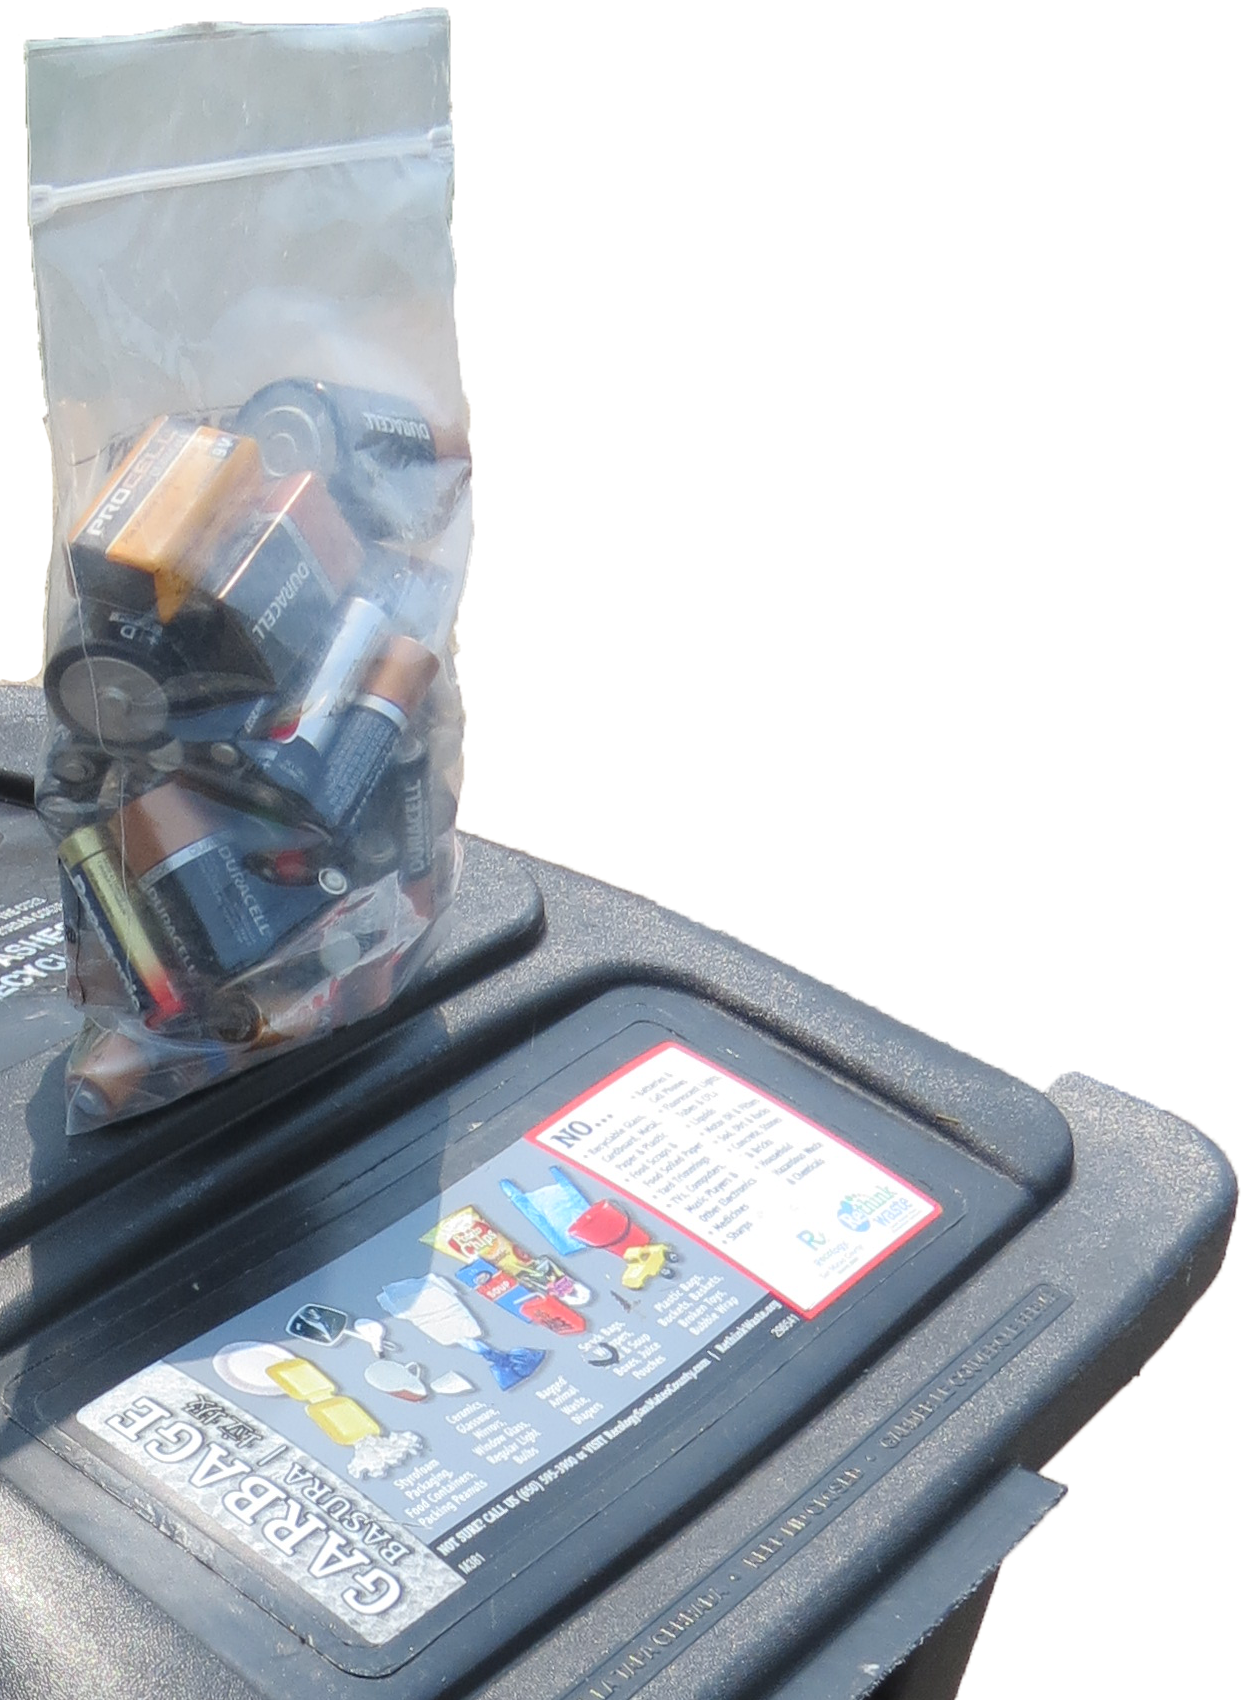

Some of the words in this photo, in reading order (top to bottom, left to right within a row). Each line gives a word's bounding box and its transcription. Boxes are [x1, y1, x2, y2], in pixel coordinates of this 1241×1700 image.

[363, 413, 430, 441] DURACELL
[86, 430, 178, 536] PROCELL
[251, 560, 310, 641] DURACELL
[405, 778, 425, 873] DURACELL
[217, 846, 271, 936] DURACELL
[147, 886, 197, 975] DURACELL
[587, 1128, 625, 1154] Recyclable
[837, 1187, 894, 1228] Rethink
[866, 1198, 911, 1226] waste
[461, 1230, 498, 1257] Chips
[486, 1280, 511, 1299] SOUP
[654, 1290, 682, 1311] Plastic
[679, 1275, 703, 1291] Bags,
[677, 1304, 707, 1327] Broken
[703, 1290, 726, 1305] Toys,
[689, 1312, 718, 1334] Bubble
[714, 1296, 738, 1313] Wrap
[600, 1321, 625, 1335] Bags,
[627, 1333, 650, 1348] Soup
[637, 1342, 660, 1358] Juice
[632, 1355, 665, 1378] Pouches
[536, 1376, 566, 1398] Bagged
[549, 1385, 578, 1407] Animal
[182, 1392, 265, 1446] 垃圾
[445, 1402, 485, 1426] Ceramics,
[456, 1405, 499, 1433] Glassware,
[560, 1397, 590, 1414] Waste,
[571, 1402, 603, 1424] Diapers
[436, 1536, 459, 1555] NOT
[455, 1518, 485, 1542] SURE?
[482, 1504, 507, 1522] CALL
[502, 1495, 519, 1507] US
[516, 1480, 544, 1501] (650)
[538, 1456, 577, 1484] 595-3900
[582, 1434, 607, 1453] VISIT
[715, 1300, 781, 1351] RethinkWaste.org
[472, 1420, 506, 1439] Mirrors,
[472, 1434, 505, 1455] Window
[503, 1422, 530, 1436] Glass,
[486, 1442, 518, 1463] Regular
[512, 1447, 538, 1463] Bulbs
[394, 1459, 438, 1489] Styrofoam
[405, 1470, 452, 1499] Packaging,
[103, 1395, 403, 1616] GARBAGE
[405, 1498, 429, 1517] Food
[427, 1472, 476, 1502] Containers,
[418, 1501, 456, 1529] Packing
[451, 1480, 487, 1504] Peanuts
[282, 1461, 411, 1564] BASURA
[458, 1552, 484, 1573] M381
